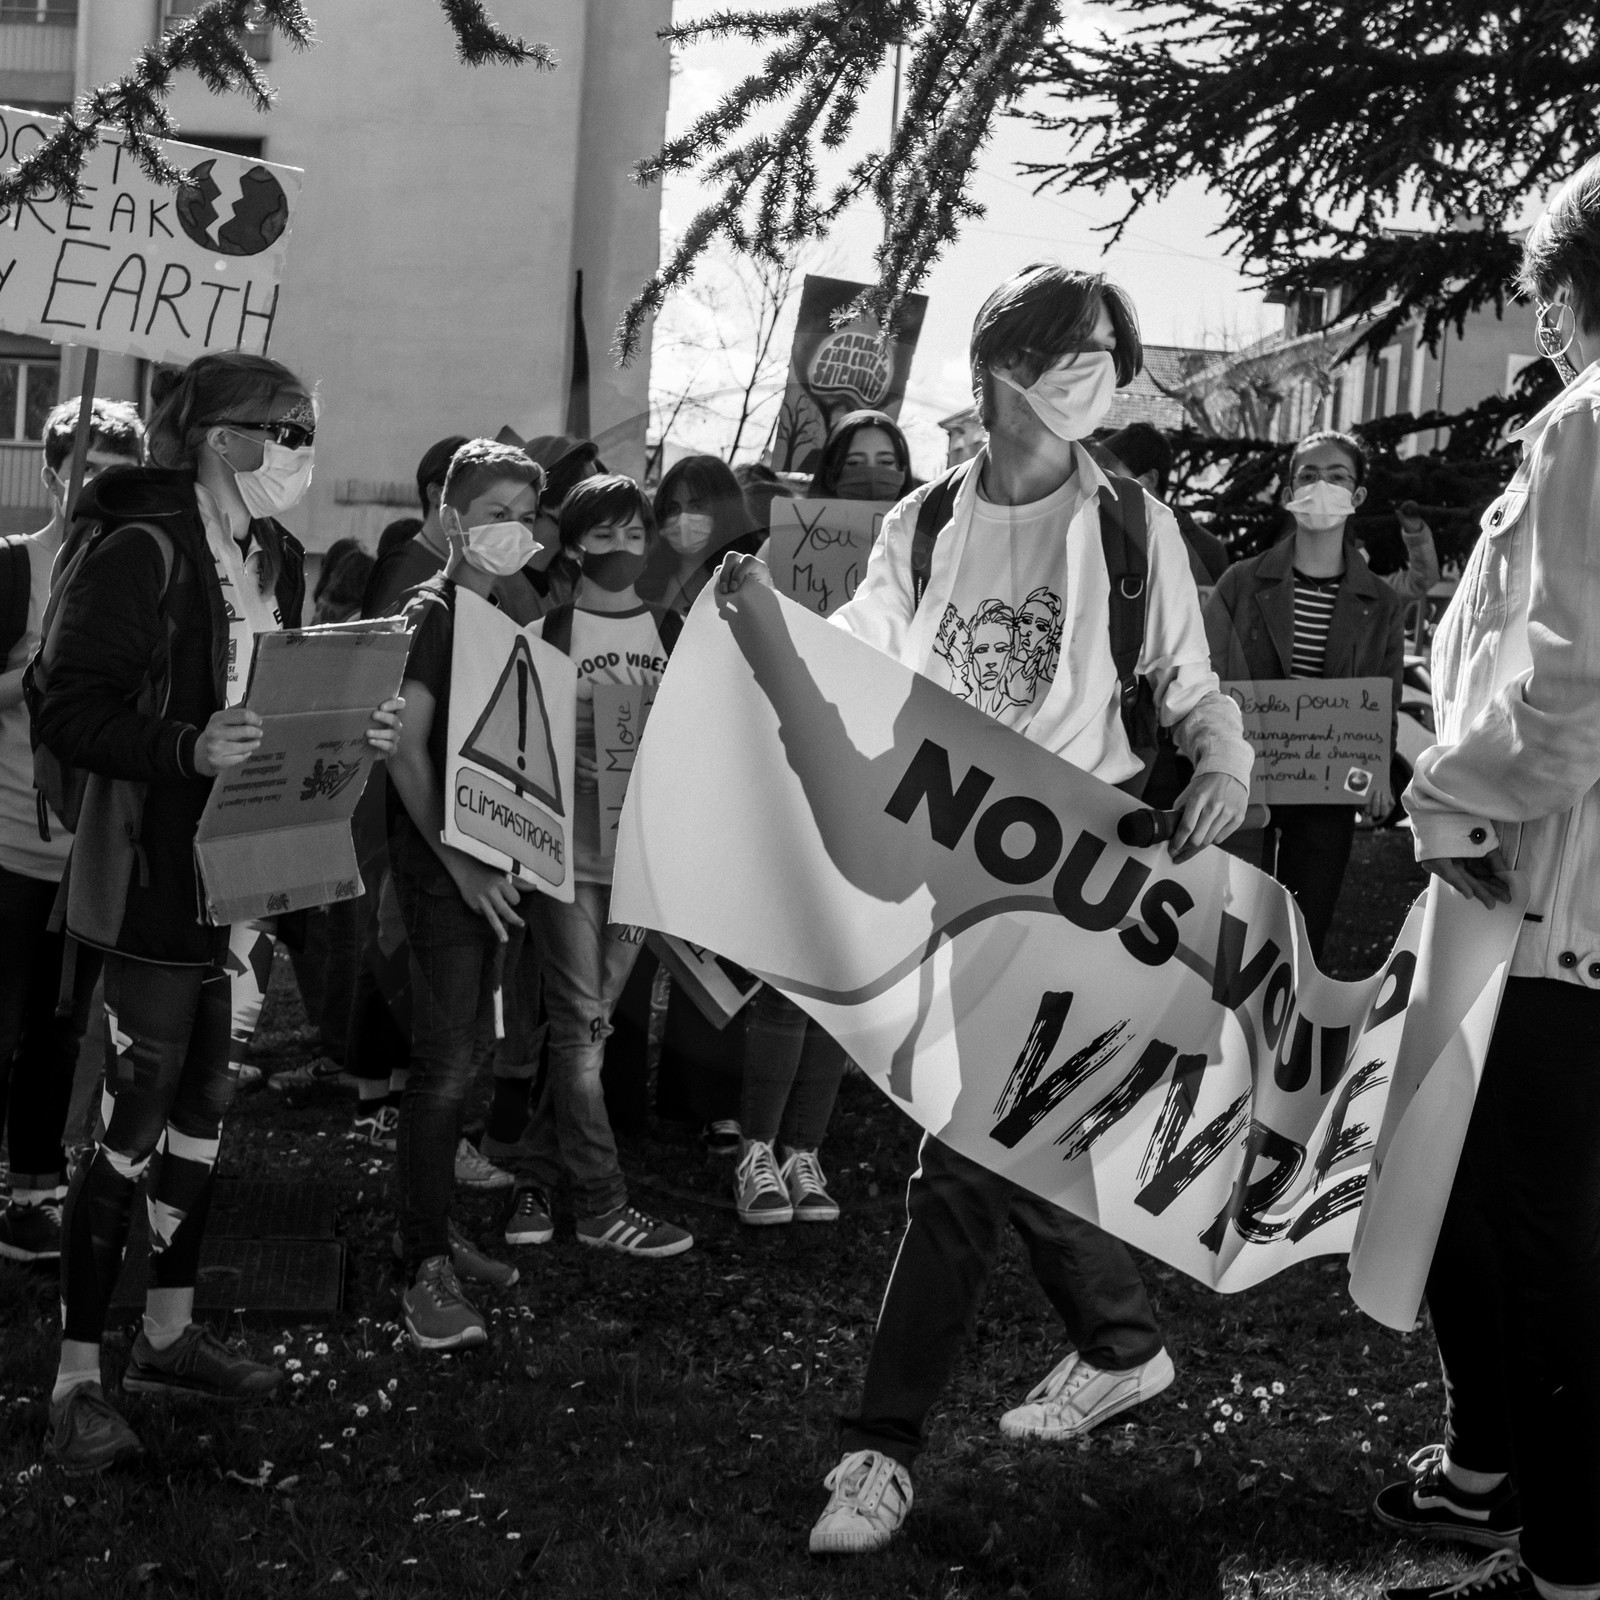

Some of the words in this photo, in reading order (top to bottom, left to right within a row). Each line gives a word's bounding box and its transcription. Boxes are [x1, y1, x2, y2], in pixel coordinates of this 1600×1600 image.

[0, 180, 174, 239] REAK
[41, 237, 280, 356] EARTH
[792, 502, 858, 560] You
[792, 562, 833, 613] My
[576, 652, 620, 680] OOD
[1295, 693, 1350, 721] pour
[1360, 689, 1381, 712] le
[605, 700, 636, 772] More
[1243, 724, 1341, 748] rangement,
[1343, 731, 1384, 744] nous
[1304, 744, 1321, 760] de
[1256, 767, 1318, 782] monde
[457, 785, 564, 866] CLiMATASTROPHE
[883, 737, 1196, 967] NOUS
[989, 989, 1390, 1258] VIVRE
